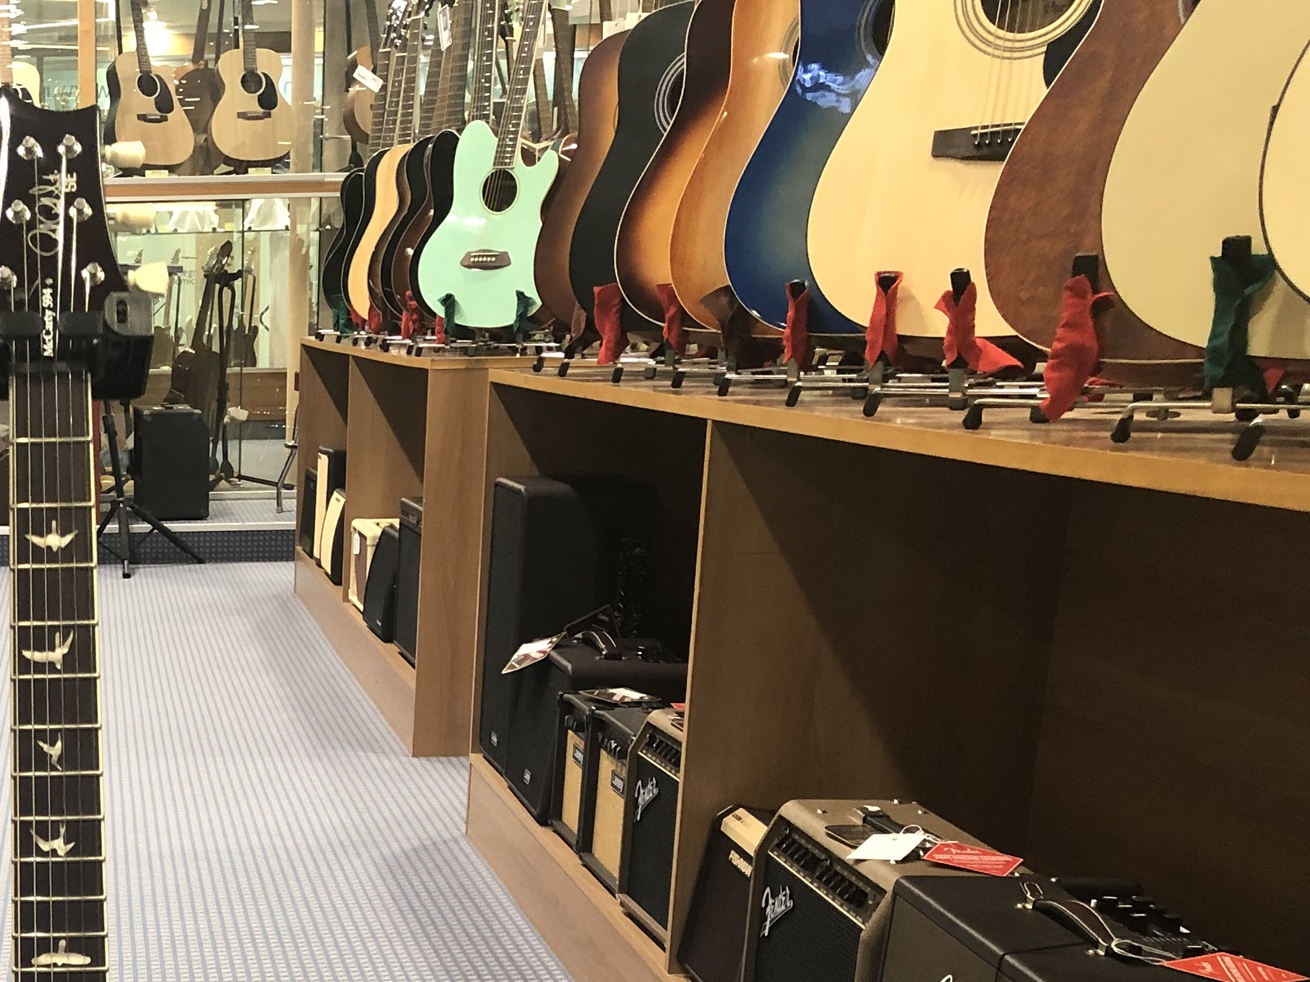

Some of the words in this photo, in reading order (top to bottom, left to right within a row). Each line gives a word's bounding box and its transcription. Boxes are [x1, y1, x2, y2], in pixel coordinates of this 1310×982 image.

[64, 171, 77, 193] SE
[42, 288, 53, 308] 594
[43, 308, 56, 357] McCarty
[634, 776, 659, 821] Fender
[760, 885, 794, 937] Fender
